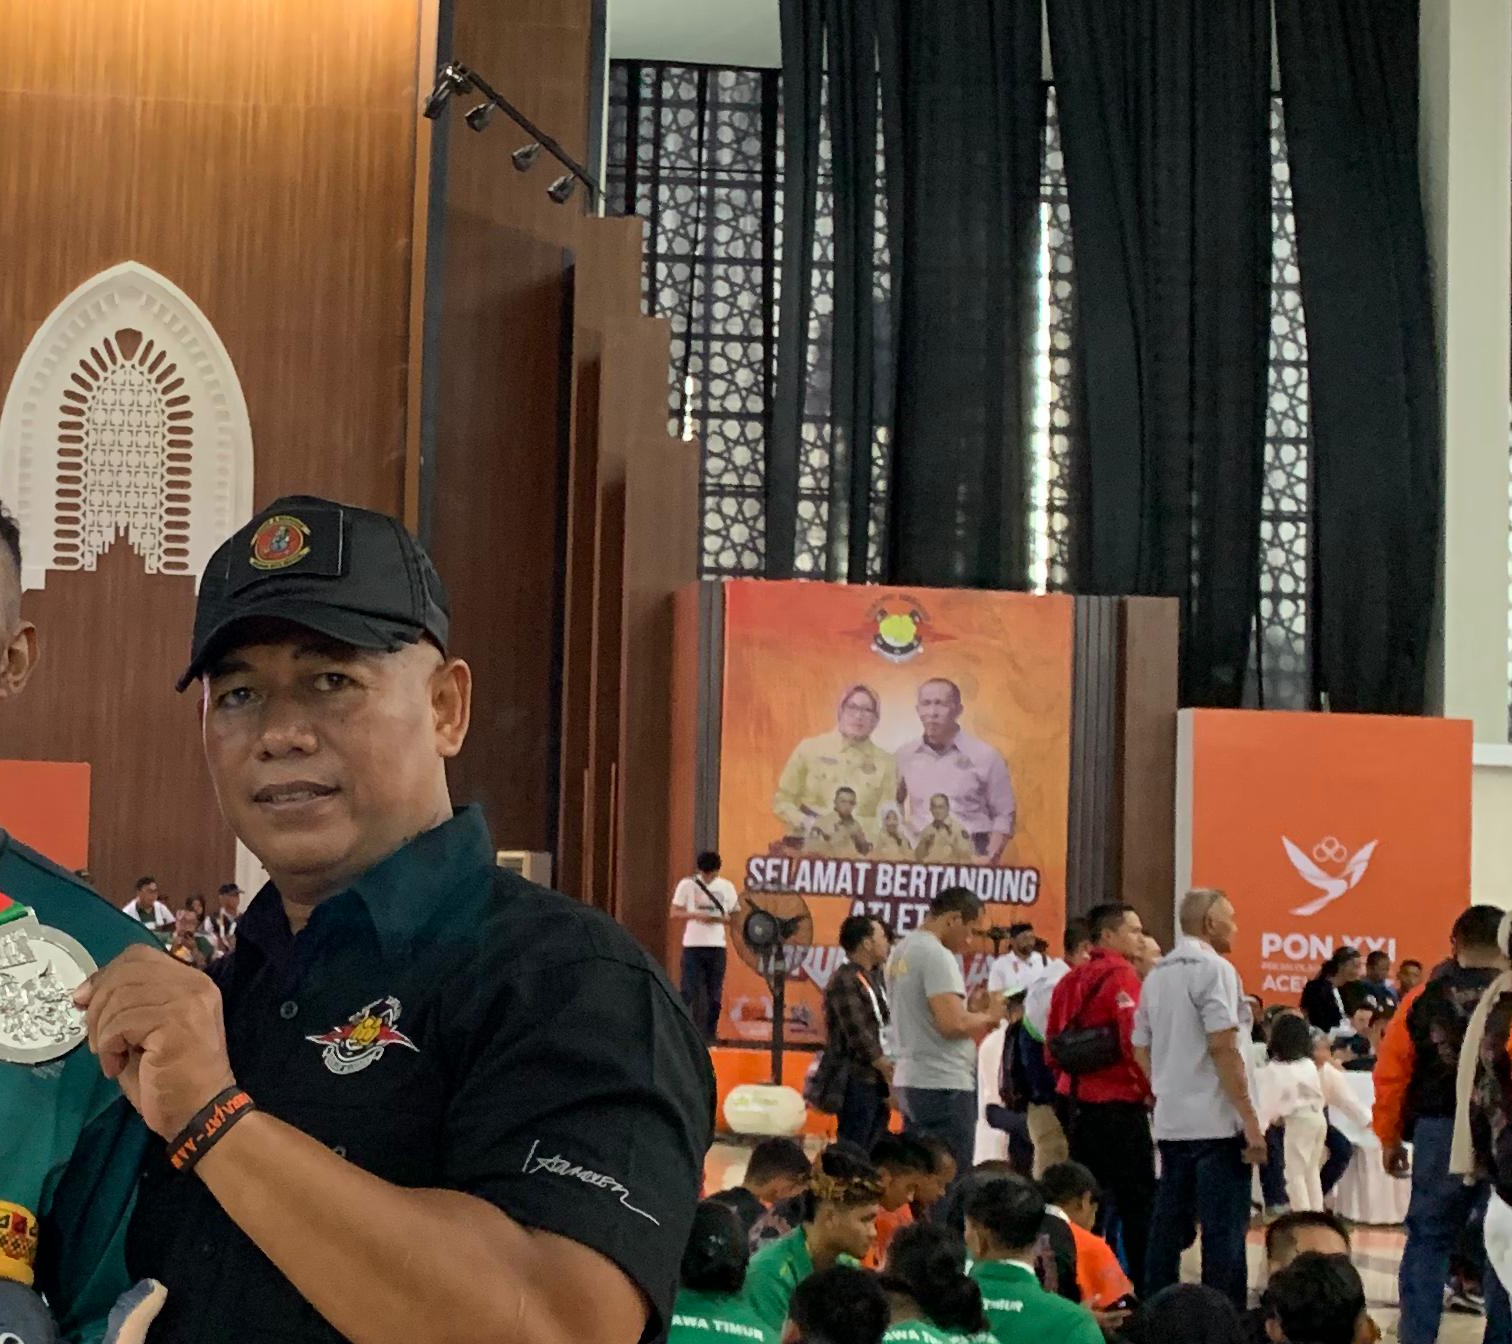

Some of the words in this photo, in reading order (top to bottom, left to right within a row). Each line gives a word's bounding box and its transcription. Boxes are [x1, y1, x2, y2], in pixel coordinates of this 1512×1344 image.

[748, 857, 872, 895] SELAMAT
[875, 863, 1038, 903] BERTANDING
[1261, 933, 1334, 960] PON
[1263, 974, 1307, 993] ACE
[672, 1314, 708, 1330] AWA
[712, 1319, 764, 1342] TIMUR
